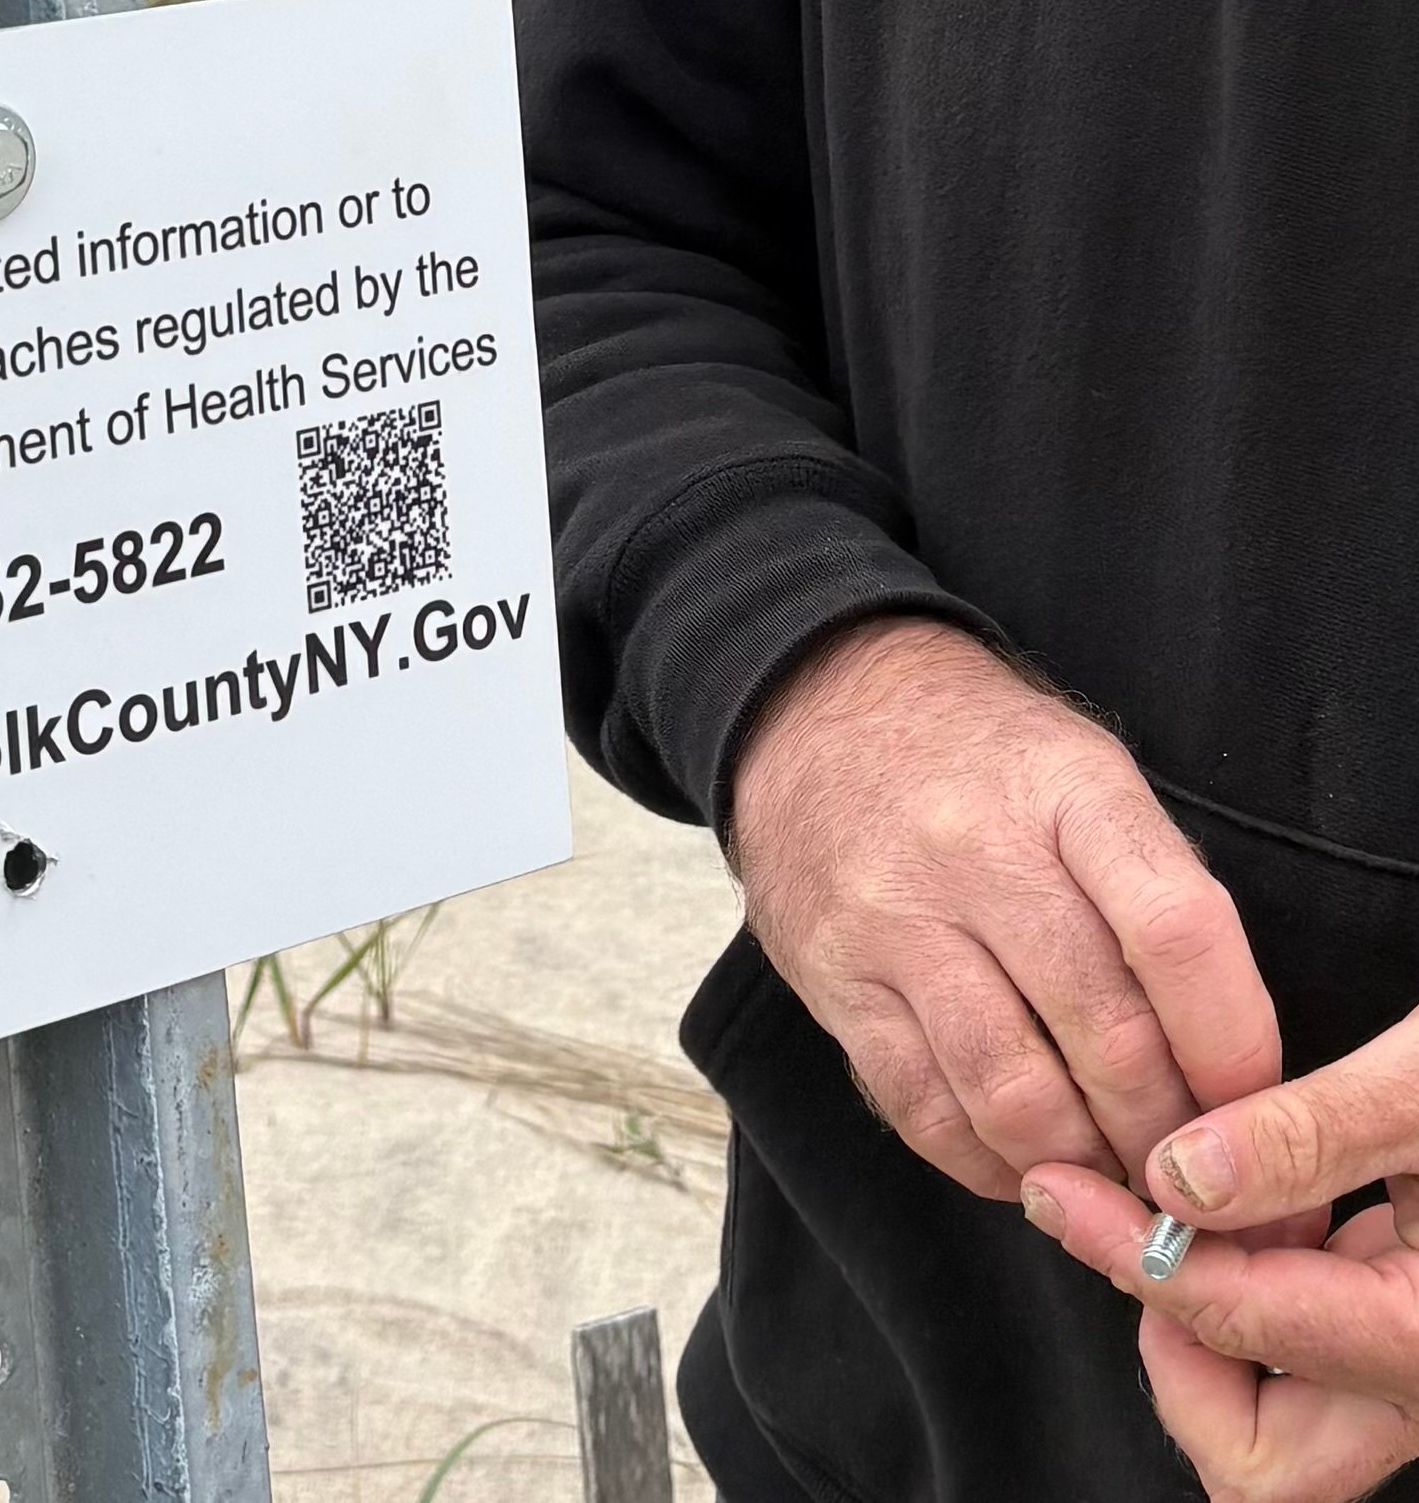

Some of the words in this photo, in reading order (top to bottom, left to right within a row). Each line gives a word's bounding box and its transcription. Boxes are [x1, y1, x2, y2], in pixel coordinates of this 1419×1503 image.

[78, 199, 322, 276] information
[339, 191, 379, 227] or
[392, 178, 429, 218] to
[137, 271, 339, 355] regulated
[356, 266, 402, 316] by
[416, 252, 478, 296] the
[108, 393, 149, 445] of
[165, 365, 305, 433] Health
[322, 333, 497, 398] Services
